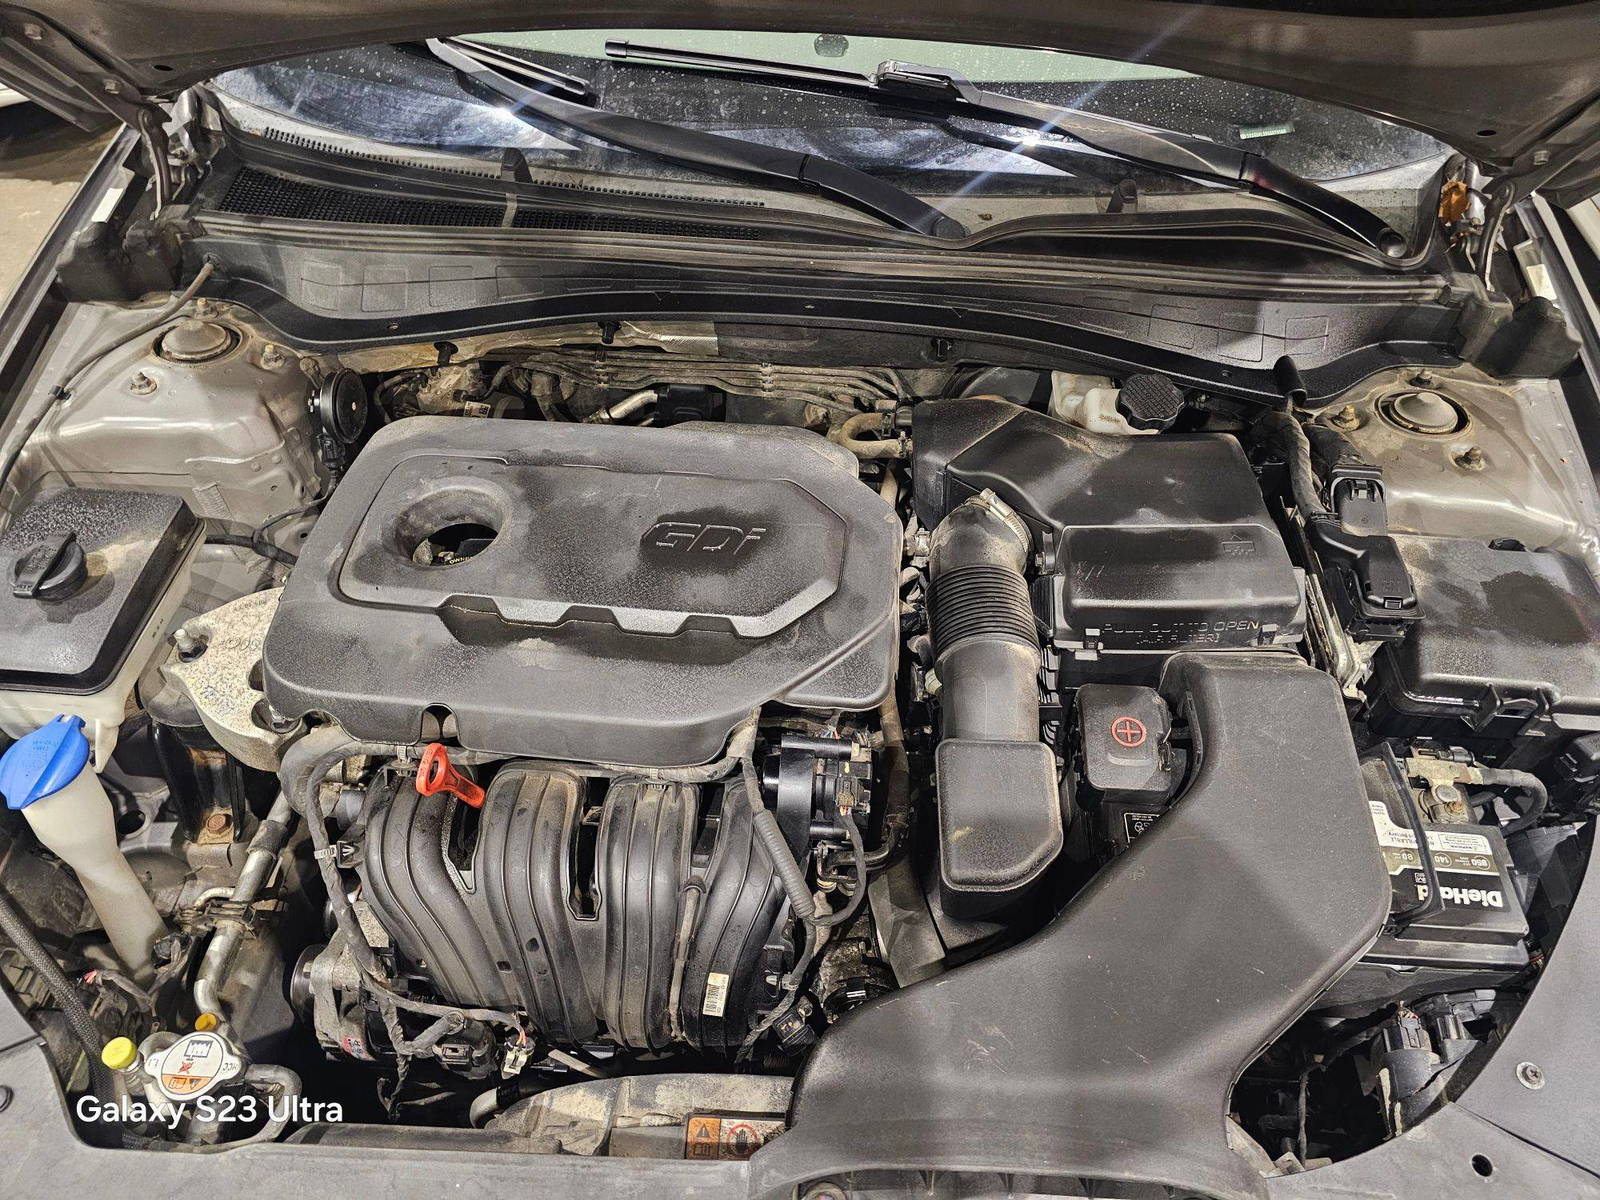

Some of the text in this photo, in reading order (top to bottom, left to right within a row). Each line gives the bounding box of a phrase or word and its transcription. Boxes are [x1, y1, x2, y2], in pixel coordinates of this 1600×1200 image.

[639, 521, 767, 556] GDi
[1213, 620, 1260, 632] OPEN
[1417, 884, 1503, 908] DieHad
